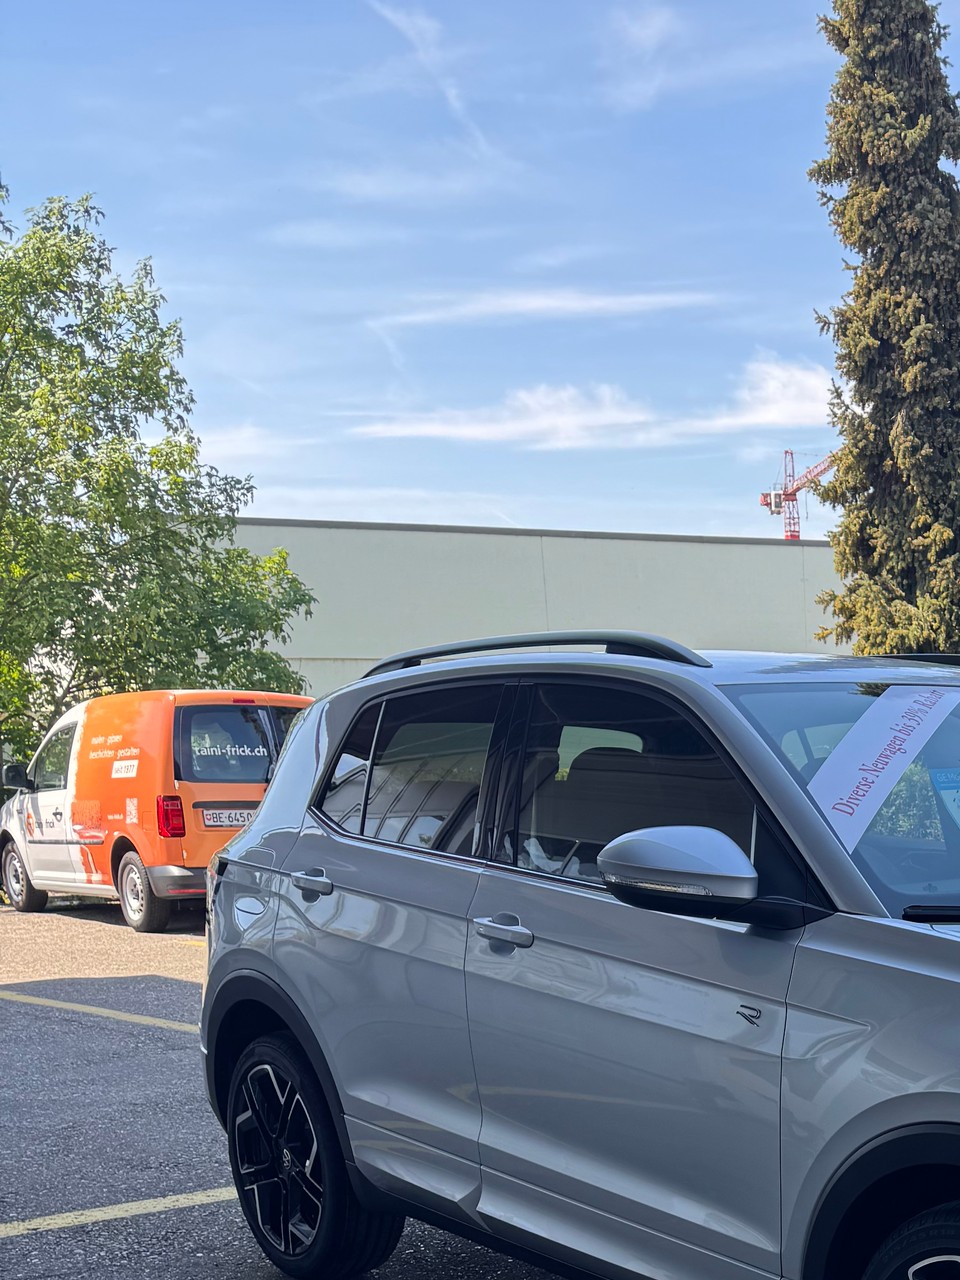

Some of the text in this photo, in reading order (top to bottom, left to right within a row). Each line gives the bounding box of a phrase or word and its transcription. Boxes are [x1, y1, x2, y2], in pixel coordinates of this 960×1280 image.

[195, 744, 268, 756] taini-frick.ch
[831, 776, 875, 817] Diverse
[858, 735, 907, 779] Neuwagen
[889, 722, 916, 738] bis
